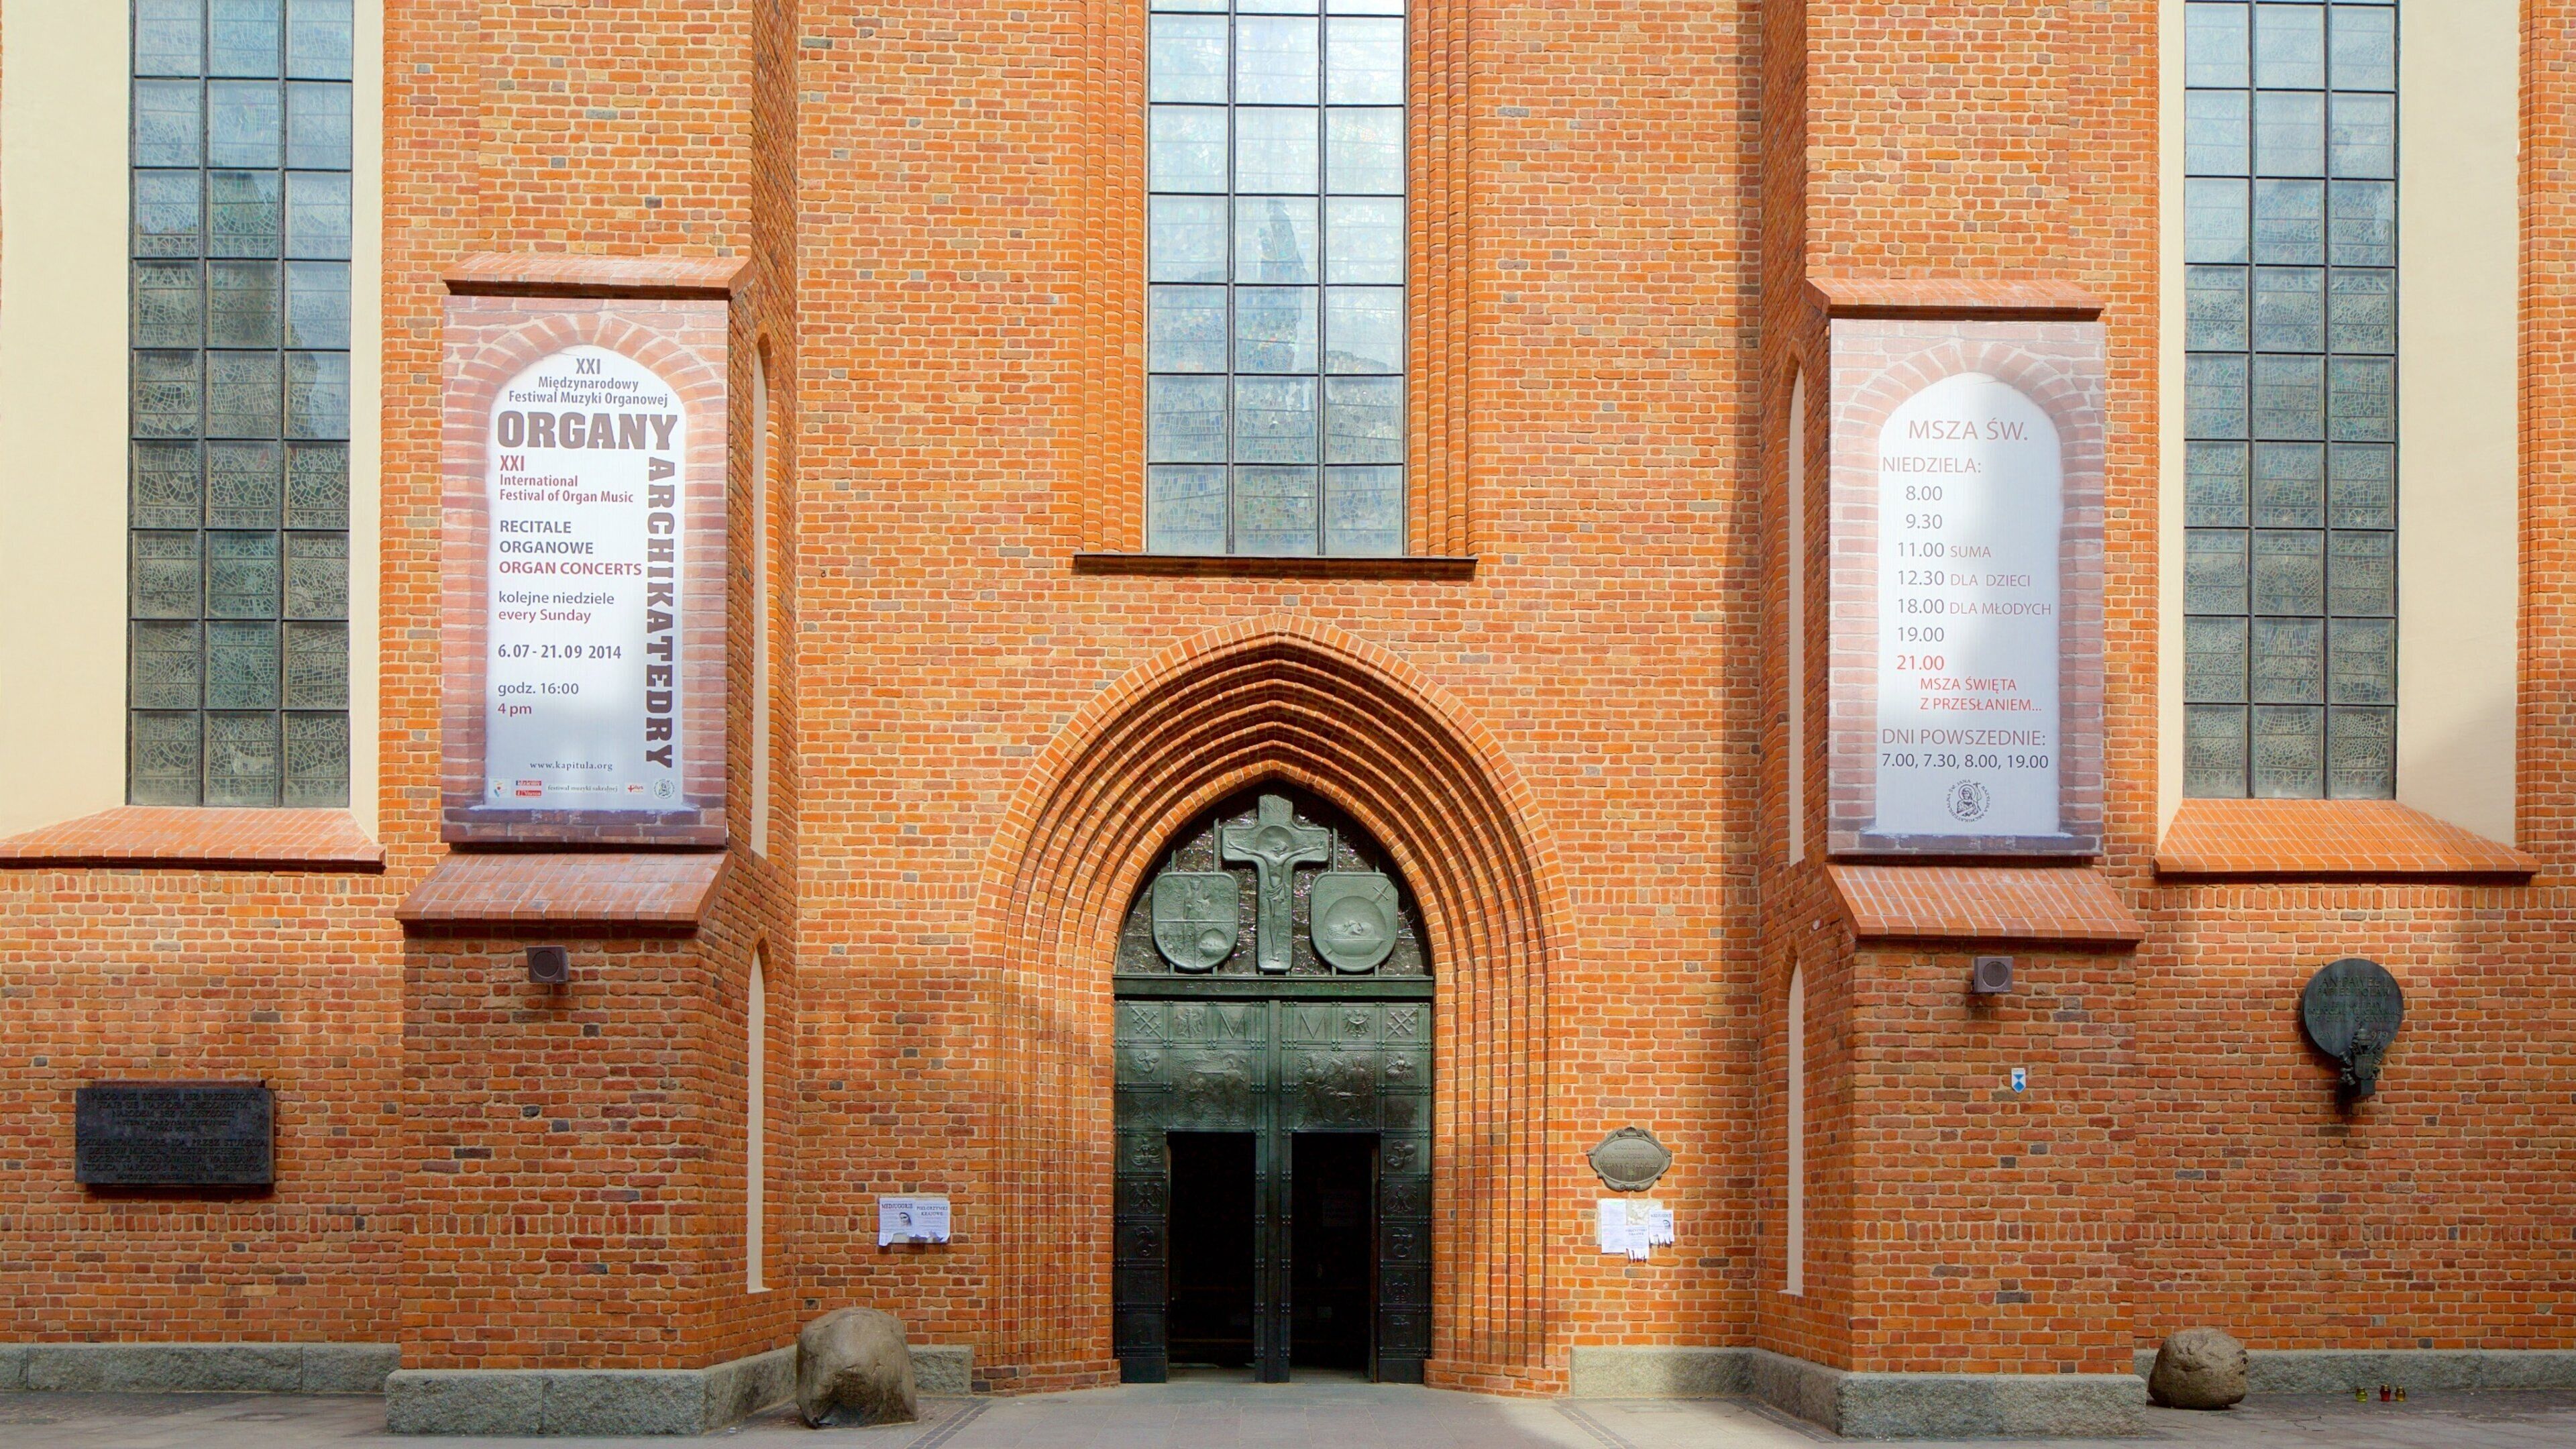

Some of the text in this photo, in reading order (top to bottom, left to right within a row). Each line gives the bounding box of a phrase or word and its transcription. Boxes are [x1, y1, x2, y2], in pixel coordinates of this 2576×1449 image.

[576, 358, 601, 374] XXI
[538, 376, 639, 392] Międzynarodowy
[508, 390, 668, 408] Festiwal Muzyki Organowej
[497, 411, 678, 450] ORGANY
[1909, 417, 2028, 441] MSZA ŚW.
[500, 455, 525, 471] XXI
[1882, 457, 1982, 474] NIEDZIELA:
[500, 474, 578, 487] International
[500, 489, 633, 505] Festival of Organ Music
[1905, 486, 1943, 501] 8.00
[500, 520, 572, 534] RECITALE
[1905, 514, 1943, 529] 9.30
[499, 541, 594, 555] ORGANOWE
[1898, 542, 1991, 558] 11.00 SUMA
[498, 561, 642, 576] ORGAN CONCERTS
[1898, 570, 2031, 587] 12.30 DLA DZIECI
[498, 591, 614, 607] kolejne niedziele
[1898, 598, 2051, 616] 18.00 DLA MŁODYCH
[498, 608, 591, 624] every Sunday
[645, 457, 675, 768] ARCHIKATEDRY
[1898, 627, 1945, 642] 19.00
[498, 645, 529, 659] 6.07
[541, 645, 582, 659] 21.09
[588, 645, 621, 659] 2014
[1897, 655, 1945, 670] 21.00
[498, 683, 579, 696] godz. 16:00
[1920, 676, 2017, 694] MSZA ŚWIĘTA
[498, 704, 532, 717] 4 pm
[1920, 698, 2041, 711] Z PRZESŁANIEM...
[1882, 729, 2045, 746] DNI POWSZEDNIE:
[530, 761, 612, 771] www.kapitula.org
[1882, 753, 2049, 769] 7.00, 7.30, 8.00, 19.00
